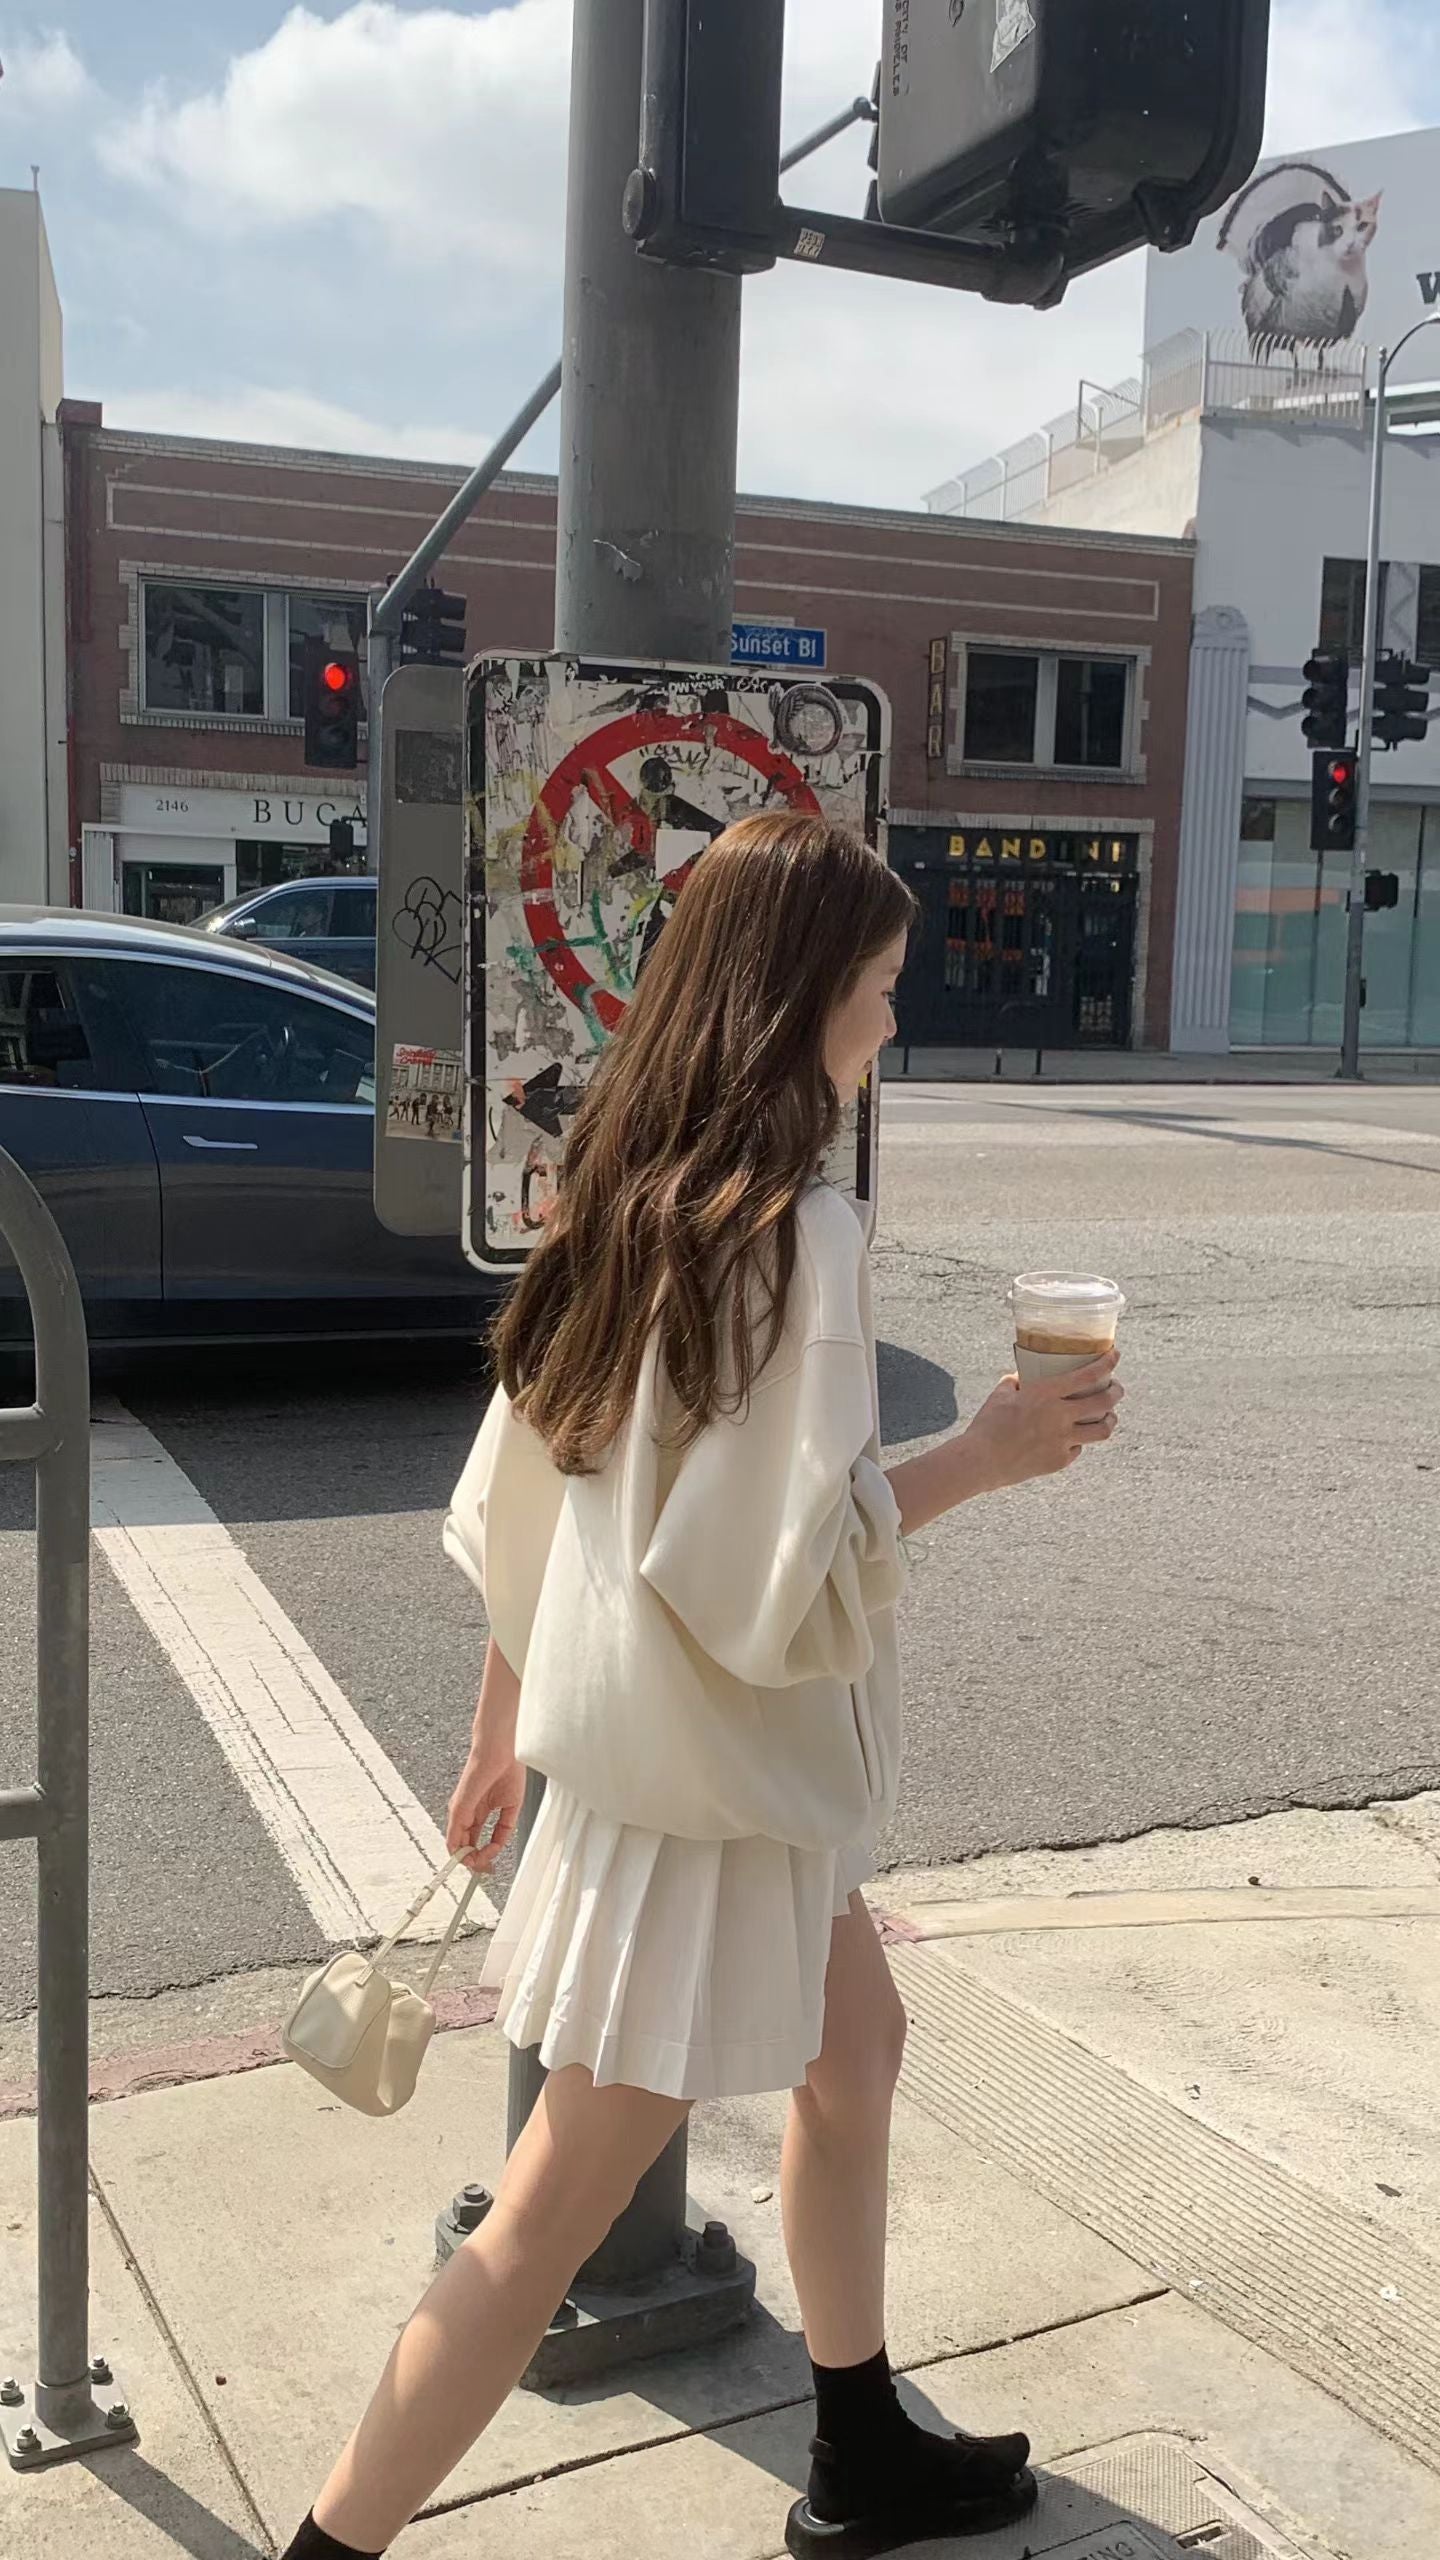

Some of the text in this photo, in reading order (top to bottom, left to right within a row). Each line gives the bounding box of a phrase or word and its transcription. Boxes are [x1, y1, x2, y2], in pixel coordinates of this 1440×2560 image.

[731, 633, 790, 656] Sunset
[928, 641, 945, 757] BAR
[156, 799, 189, 812] 2146
